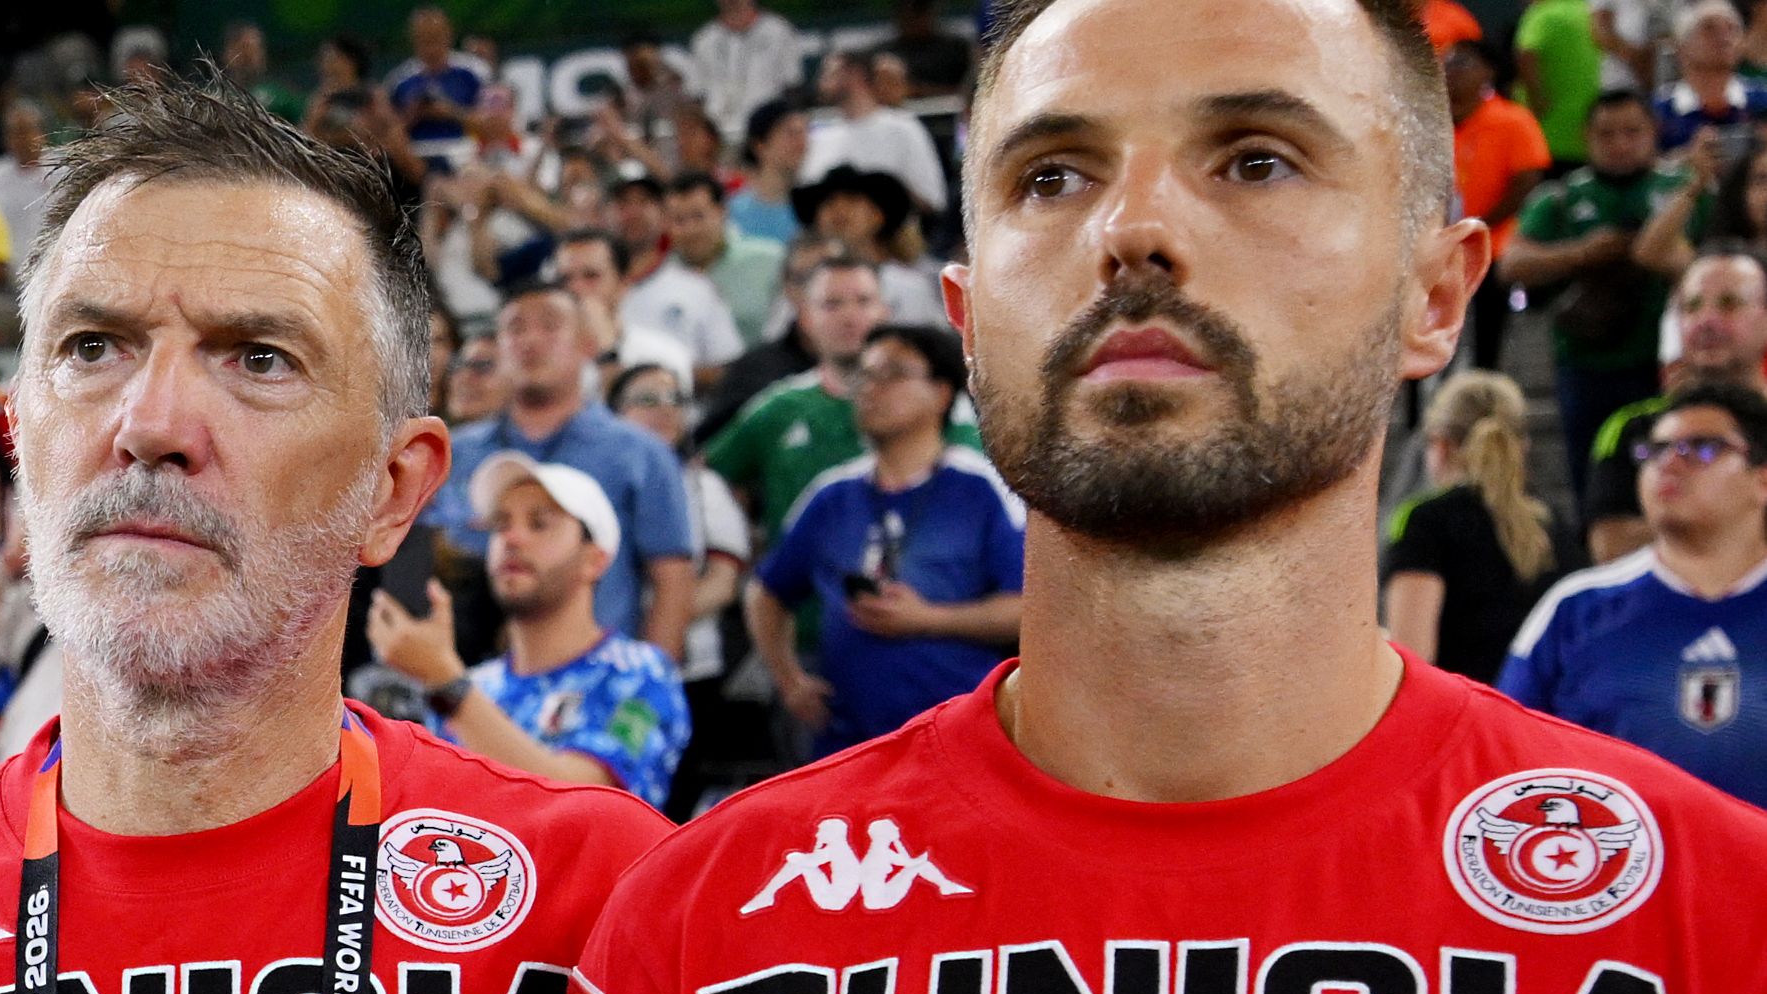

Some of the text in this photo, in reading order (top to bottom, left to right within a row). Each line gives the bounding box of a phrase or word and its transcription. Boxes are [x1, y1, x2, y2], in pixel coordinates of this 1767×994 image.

[340, 854, 367, 916] FIFA
[377, 868, 522, 940] FEDERATION TUNISIENNE DE FOOTBALL
[1501, 892, 1588, 917] TUNISIENNE
[1590, 899, 1611, 914] DE
[25, 889, 50, 990] 2026
